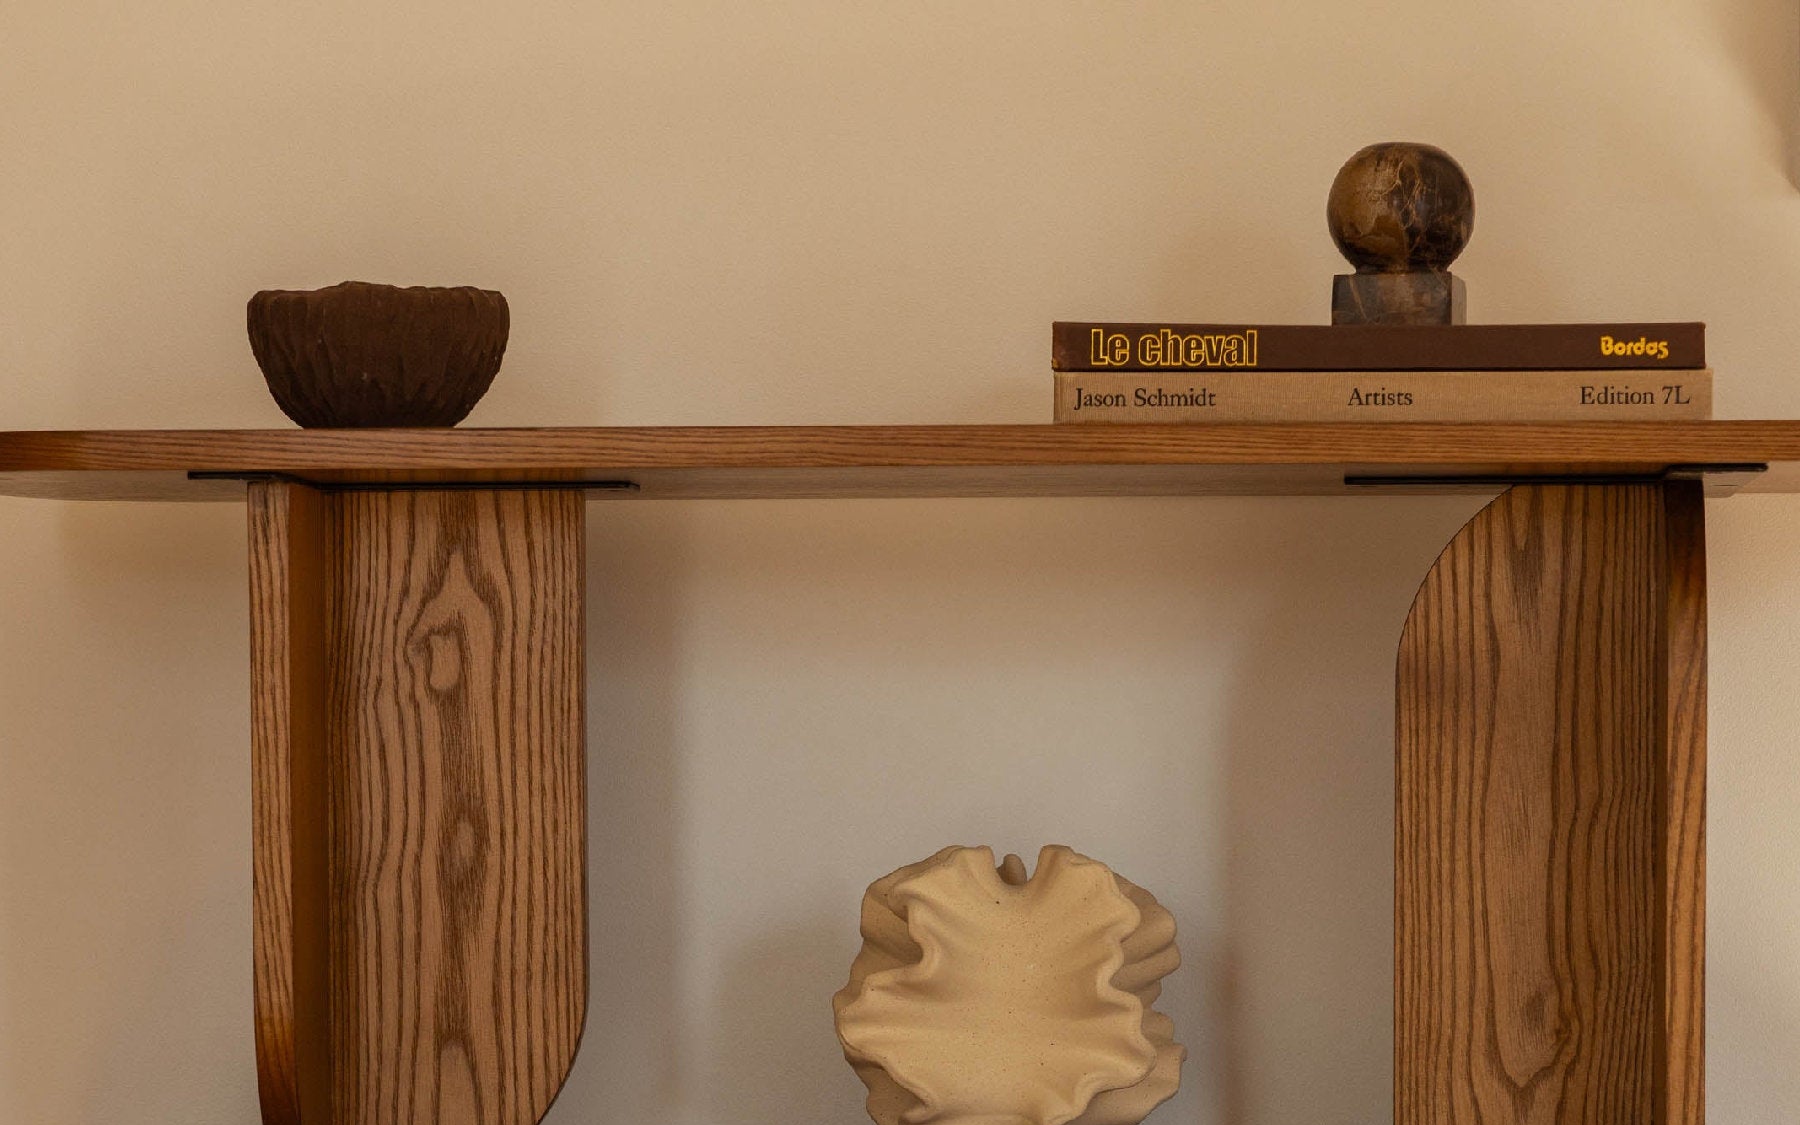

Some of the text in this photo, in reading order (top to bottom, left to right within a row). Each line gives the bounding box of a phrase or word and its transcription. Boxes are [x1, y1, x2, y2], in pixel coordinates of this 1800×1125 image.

[1090, 328, 1258, 368] Le cheval
[1600, 335, 1670, 360] Bordas
[1073, 386, 1217, 411] Jason Schmidt
[1347, 387, 1414, 406] Artists
[1580, 385, 1692, 406] Edition 7L
